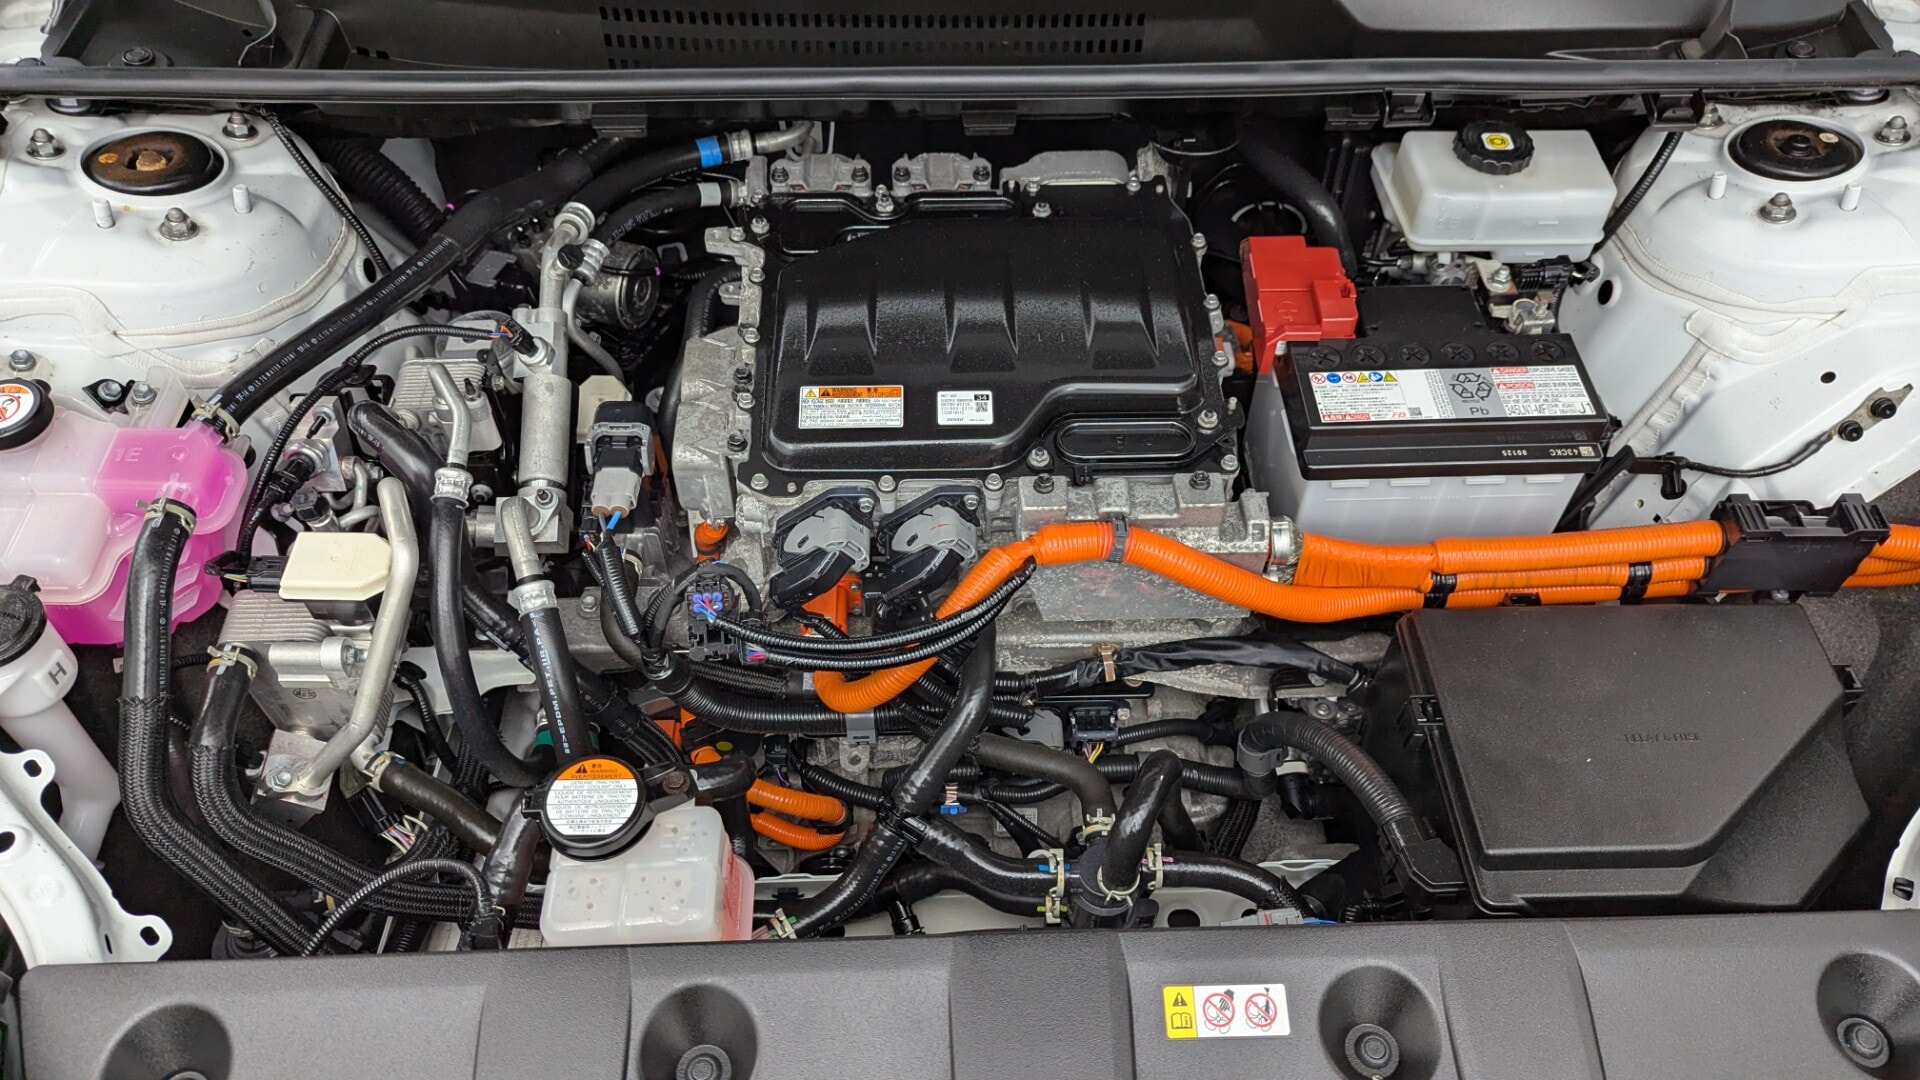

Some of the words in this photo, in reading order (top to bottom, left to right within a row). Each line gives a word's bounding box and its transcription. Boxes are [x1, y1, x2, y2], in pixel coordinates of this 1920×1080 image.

[1470, 407, 1489, 415] Pb
[1578, 403, 1595, 414] J1
[48, 662, 67, 685] H
